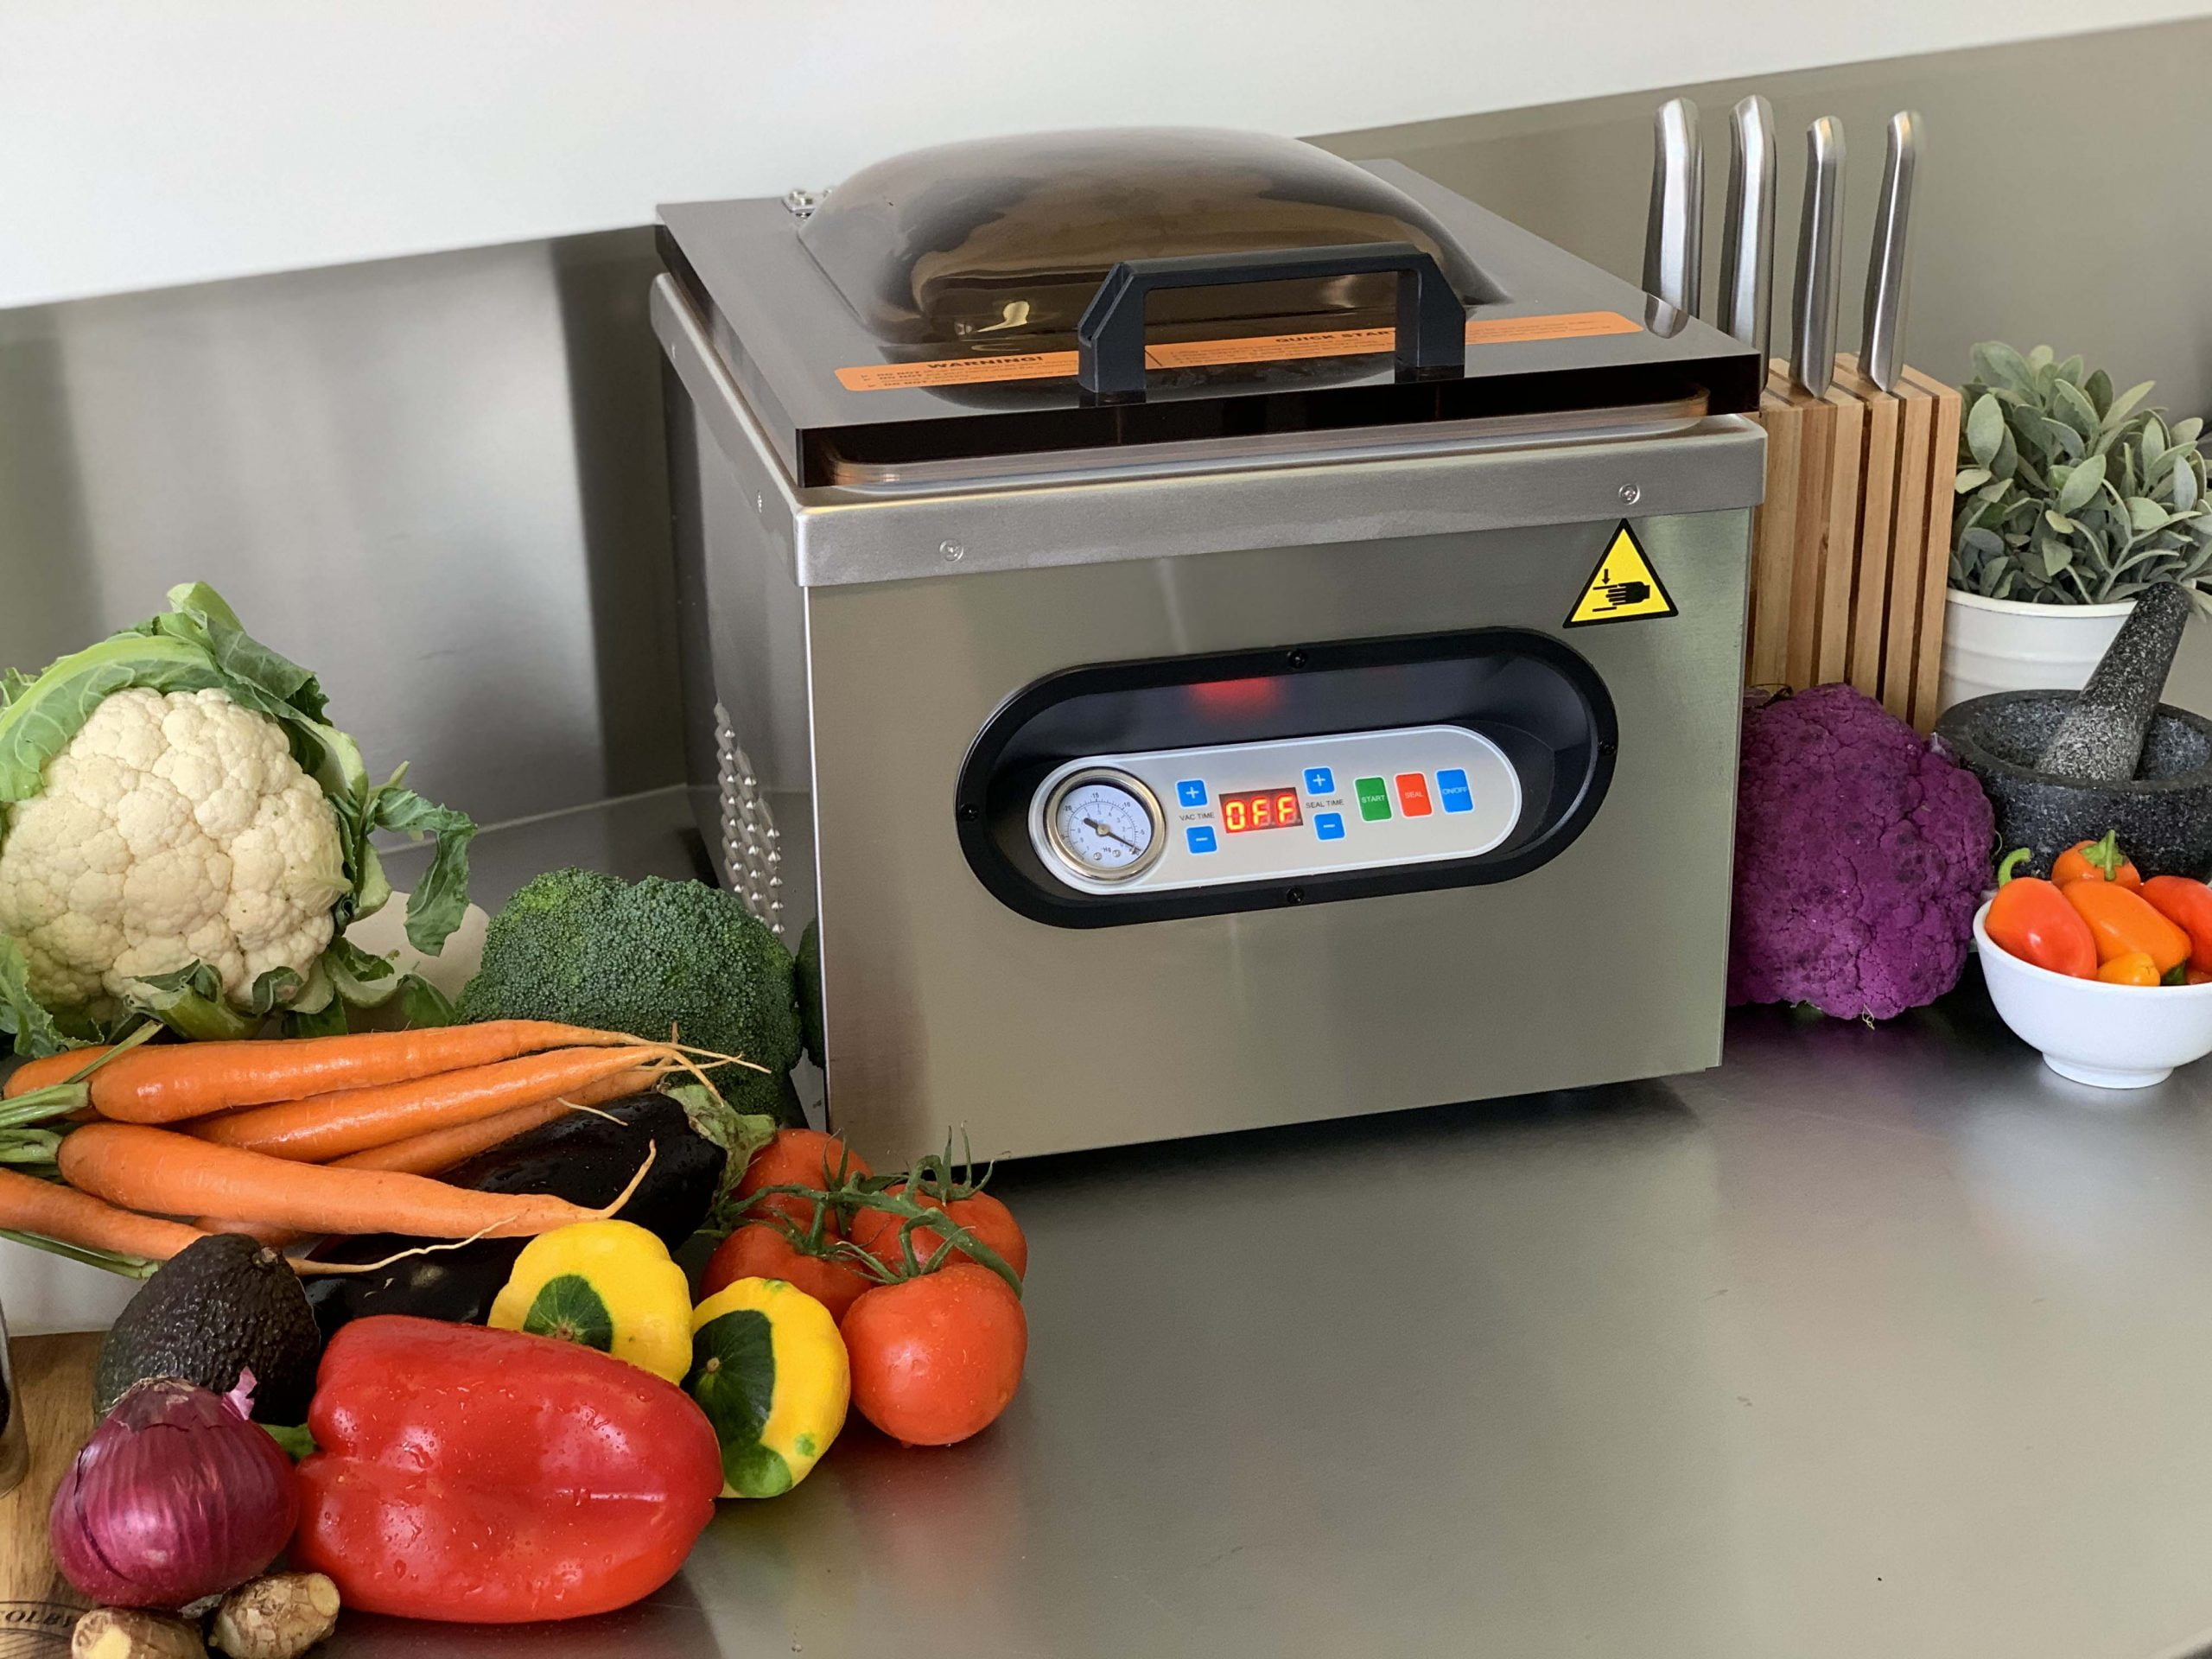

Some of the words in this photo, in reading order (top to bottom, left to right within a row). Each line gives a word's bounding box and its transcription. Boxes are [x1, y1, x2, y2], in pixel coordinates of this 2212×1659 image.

[1275, 334, 1335, 343] QUICK
[927, 356, 1044, 368] WARNING!
[1361, 794, 1386, 804] START
